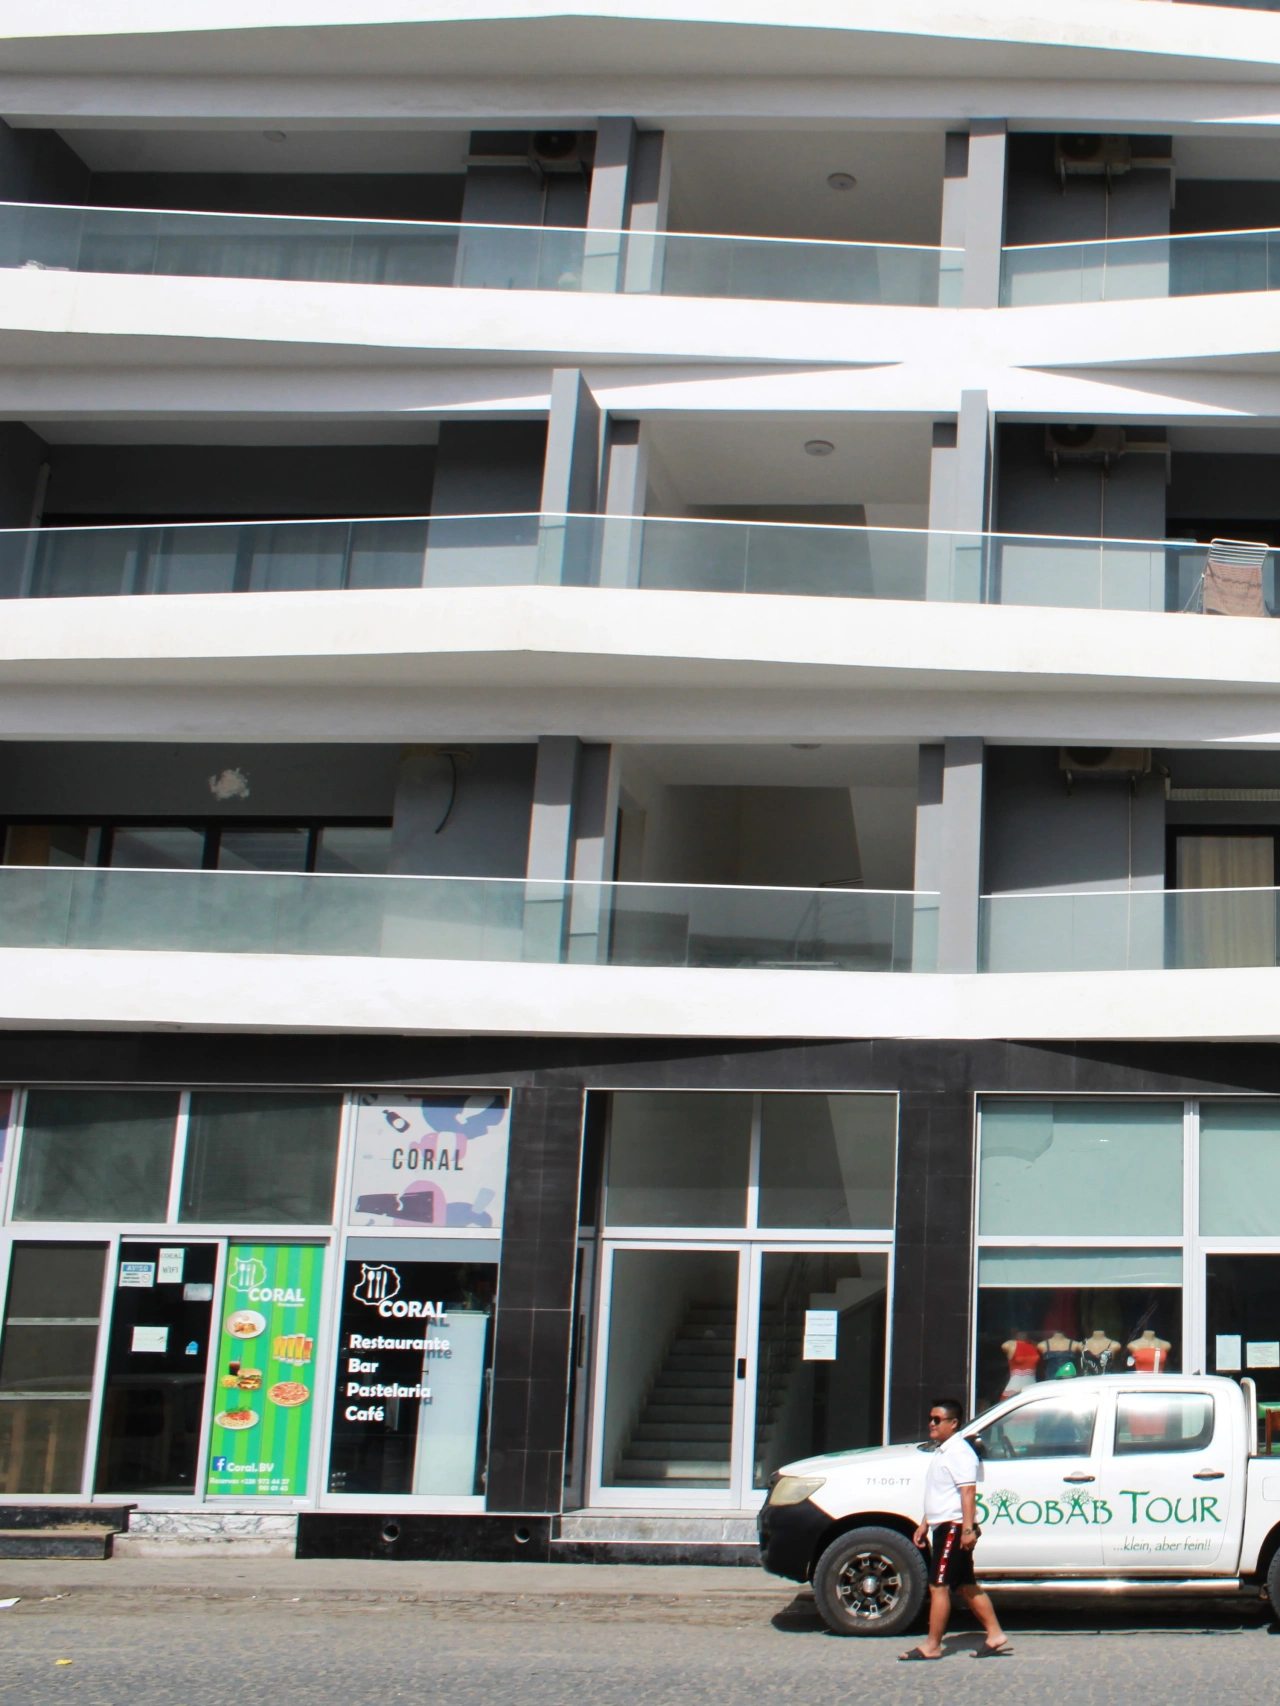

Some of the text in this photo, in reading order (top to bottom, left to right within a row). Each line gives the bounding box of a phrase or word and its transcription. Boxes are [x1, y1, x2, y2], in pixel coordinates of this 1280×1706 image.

[392, 1148, 464, 1170] CORAL
[248, 1287, 306, 1302] CORAL
[378, 1301, 448, 1318] CORAL
[350, 1334, 450, 1350] Restaurante
[348, 1358, 379, 1373] Bar
[346, 1382, 432, 1398] Pastelaria
[345, 1406, 384, 1421] Café
[1155, 1536, 1181, 1551] aber
[1184, 1536, 1211, 1552] fein!!
